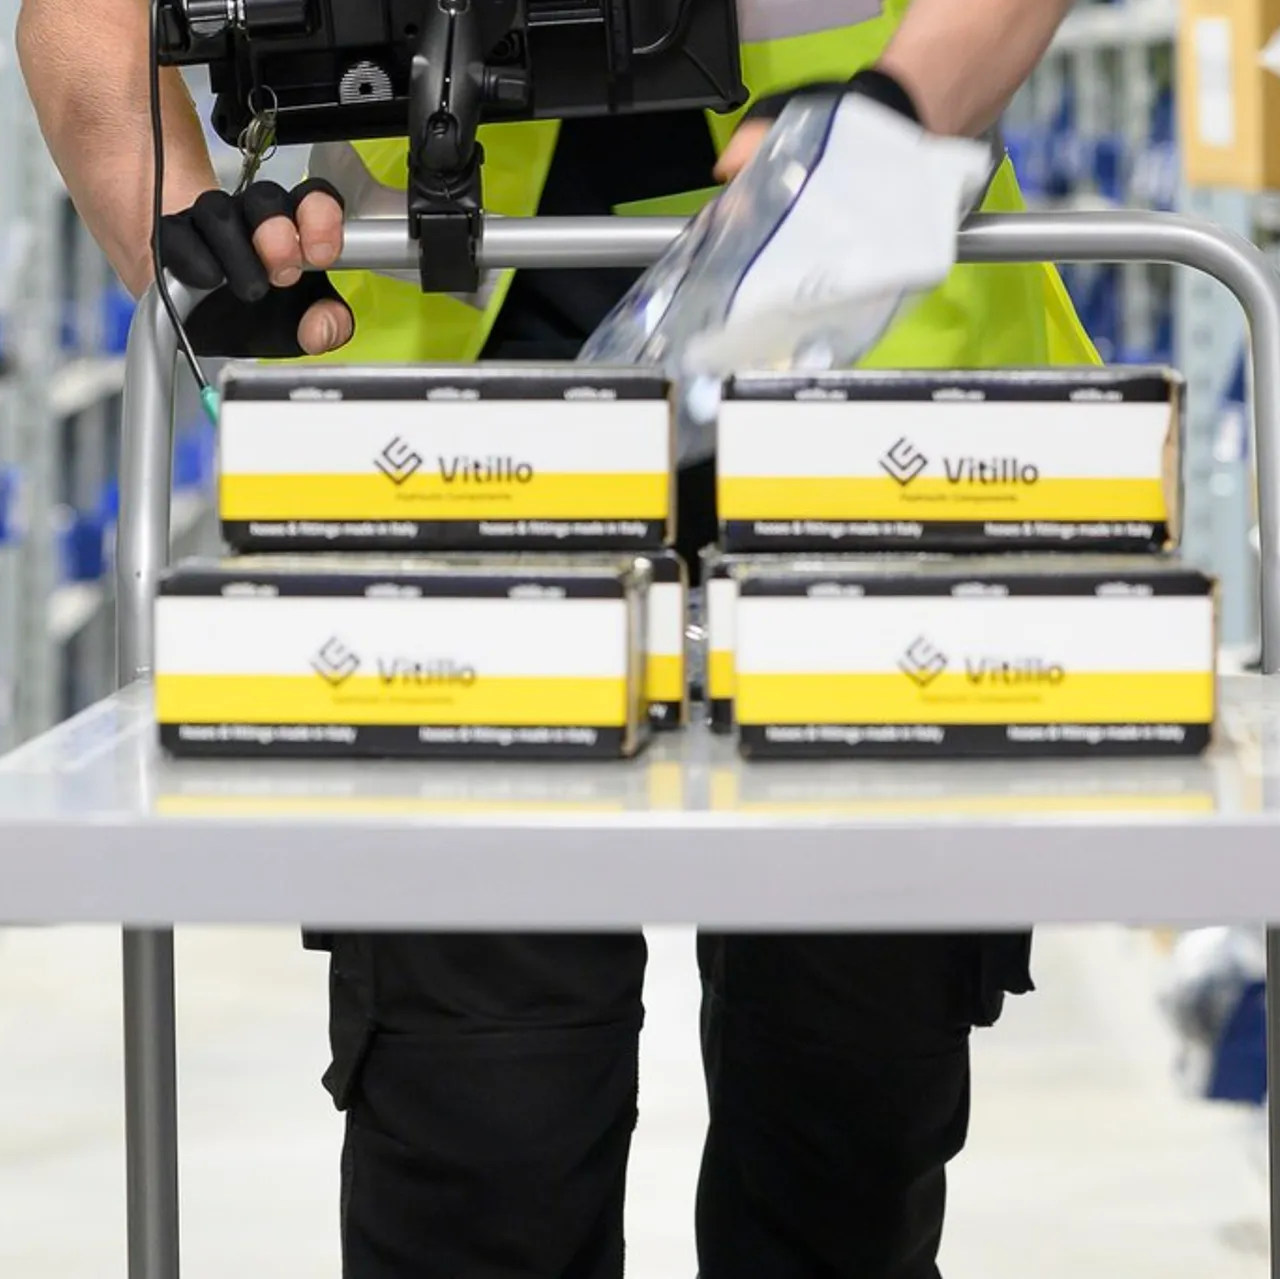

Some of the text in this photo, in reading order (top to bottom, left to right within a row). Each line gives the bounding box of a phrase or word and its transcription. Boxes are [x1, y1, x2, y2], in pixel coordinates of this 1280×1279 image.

[438, 456, 534, 484] Vitillo
[943, 457, 1039, 485] Vitillo
[377, 656, 478, 687] Vitillo
[964, 656, 1065, 687] Vitillo
